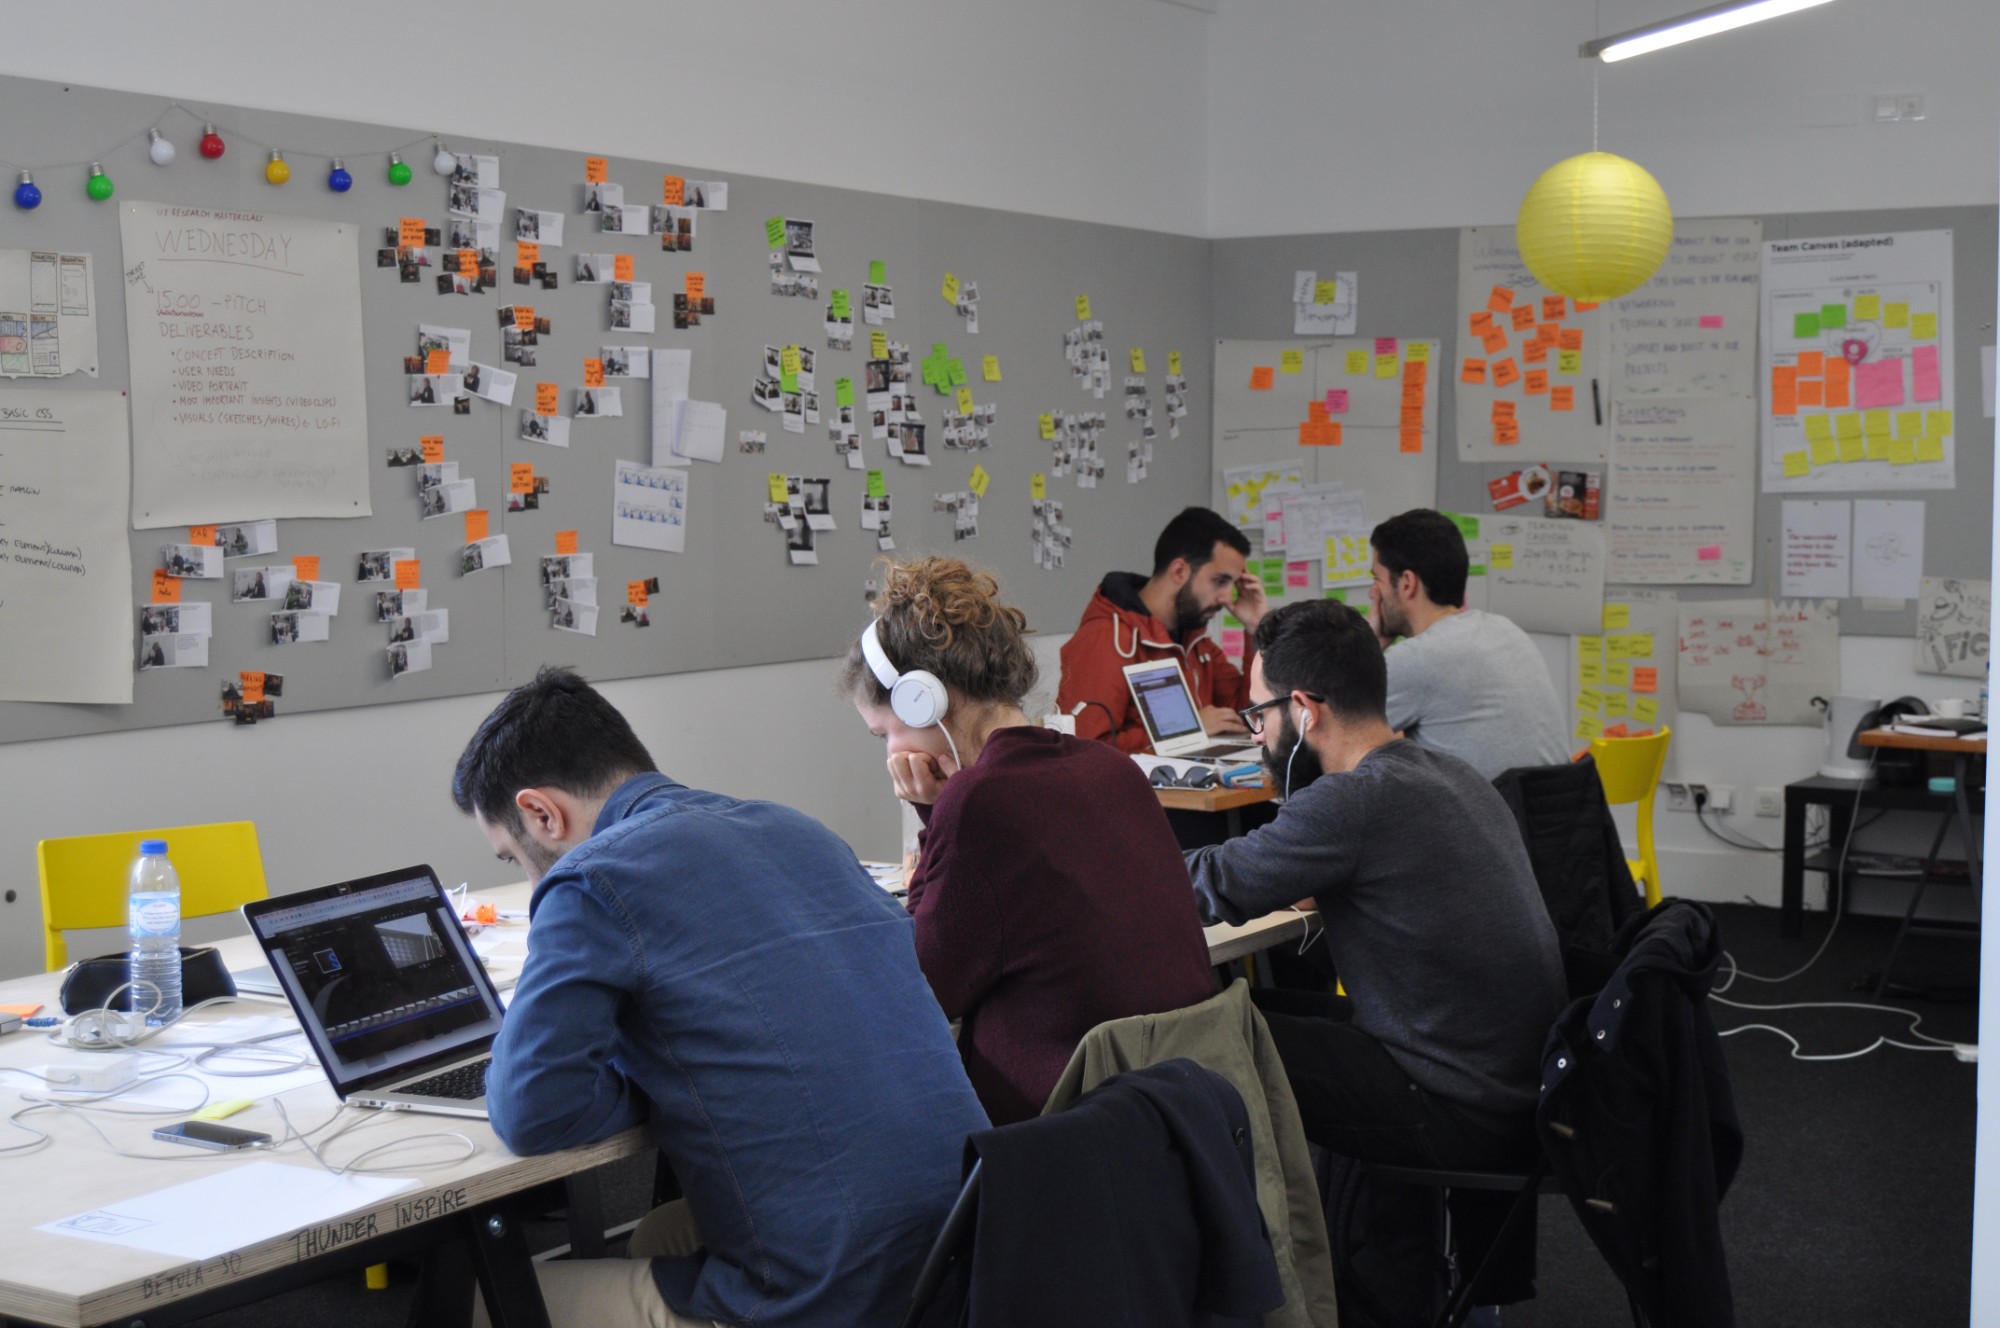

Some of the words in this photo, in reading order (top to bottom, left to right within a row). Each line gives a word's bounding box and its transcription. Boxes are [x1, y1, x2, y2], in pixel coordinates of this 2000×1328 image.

[171, 207, 210, 219] RESEARCH
[154, 228, 292, 266] WEDNESDAY
[1771, 243, 1799, 253] Team
[1801, 241, 1839, 252] Canvas
[1841, 236, 1894, 249] (adapted)
[159, 321, 255, 341] DELIVERABLES
[176, 347, 226, 363] CONCEPT
[230, 346, 295, 361] DESCRIPTION
[178, 366, 204, 377] USER
[207, 366, 236, 377] NEEDS
[177, 381, 204, 393] VIDEO
[208, 380, 249, 393] PORTRAIT
[202, 393, 246, 406] IMPORTANT
[35, 408, 54, 419] CSS
[178, 412, 215, 424] VISUALS
[287, 1213, 380, 1264] THUNDER
[395, 1187, 469, 1229] INSPIRE
